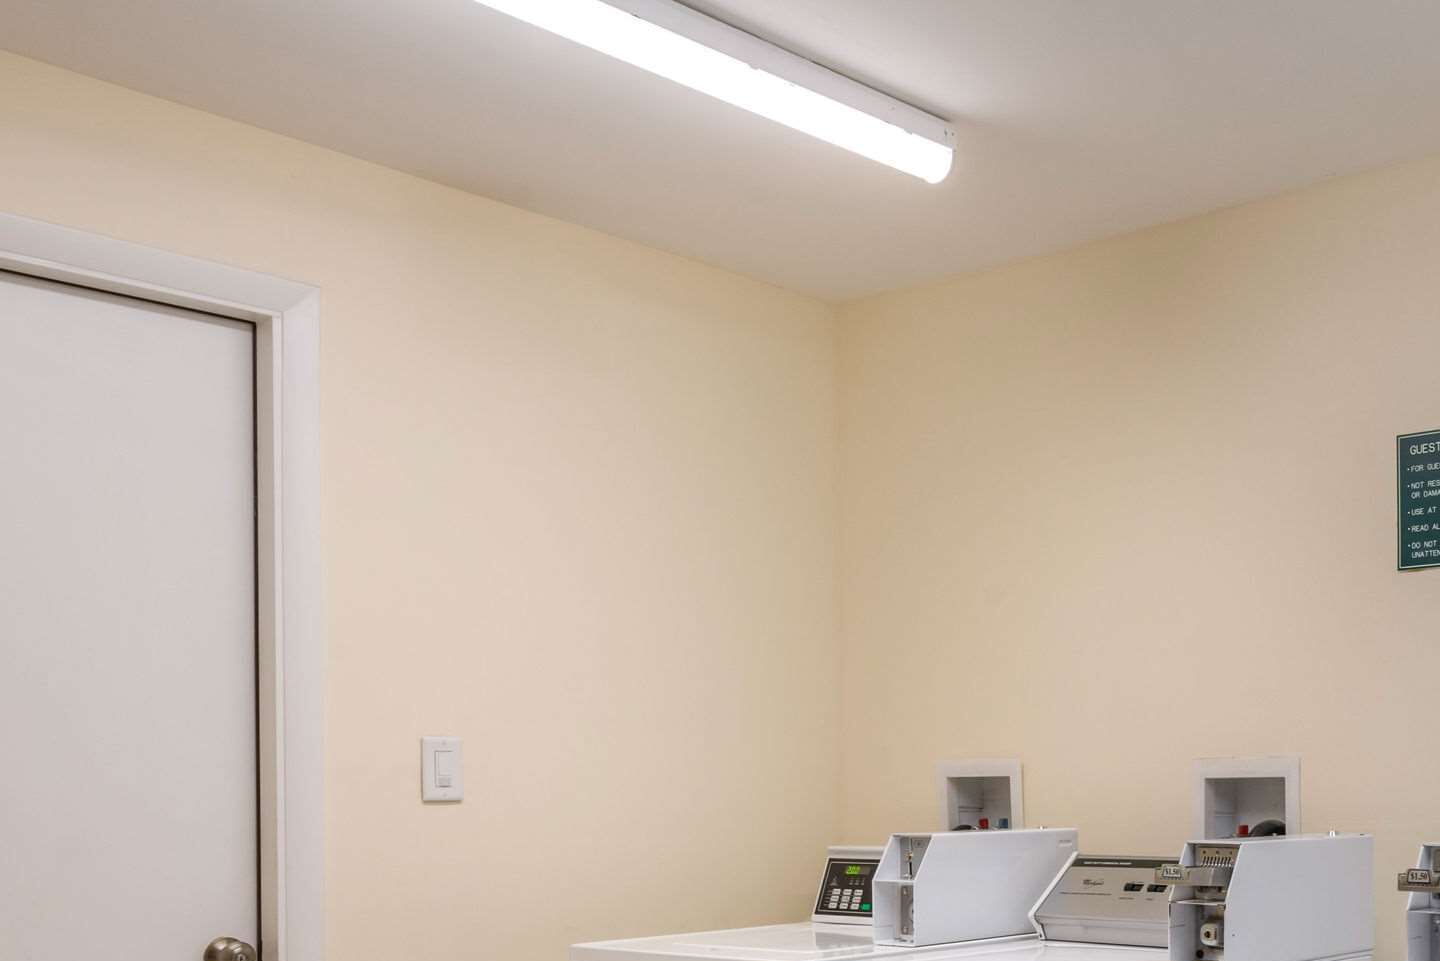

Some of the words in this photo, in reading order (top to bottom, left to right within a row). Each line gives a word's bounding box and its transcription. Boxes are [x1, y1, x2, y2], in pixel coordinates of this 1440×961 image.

[1410, 464, 1425, 473] FOR
[1411, 481, 1425, 490] NOT
[1410, 491, 1421, 499] OR
[1411, 508, 1424, 516] USE
[1411, 524, 1429, 532] READ
[1423, 540, 1437, 548] NOT
[1410, 871, 1428, 881] $1.50
